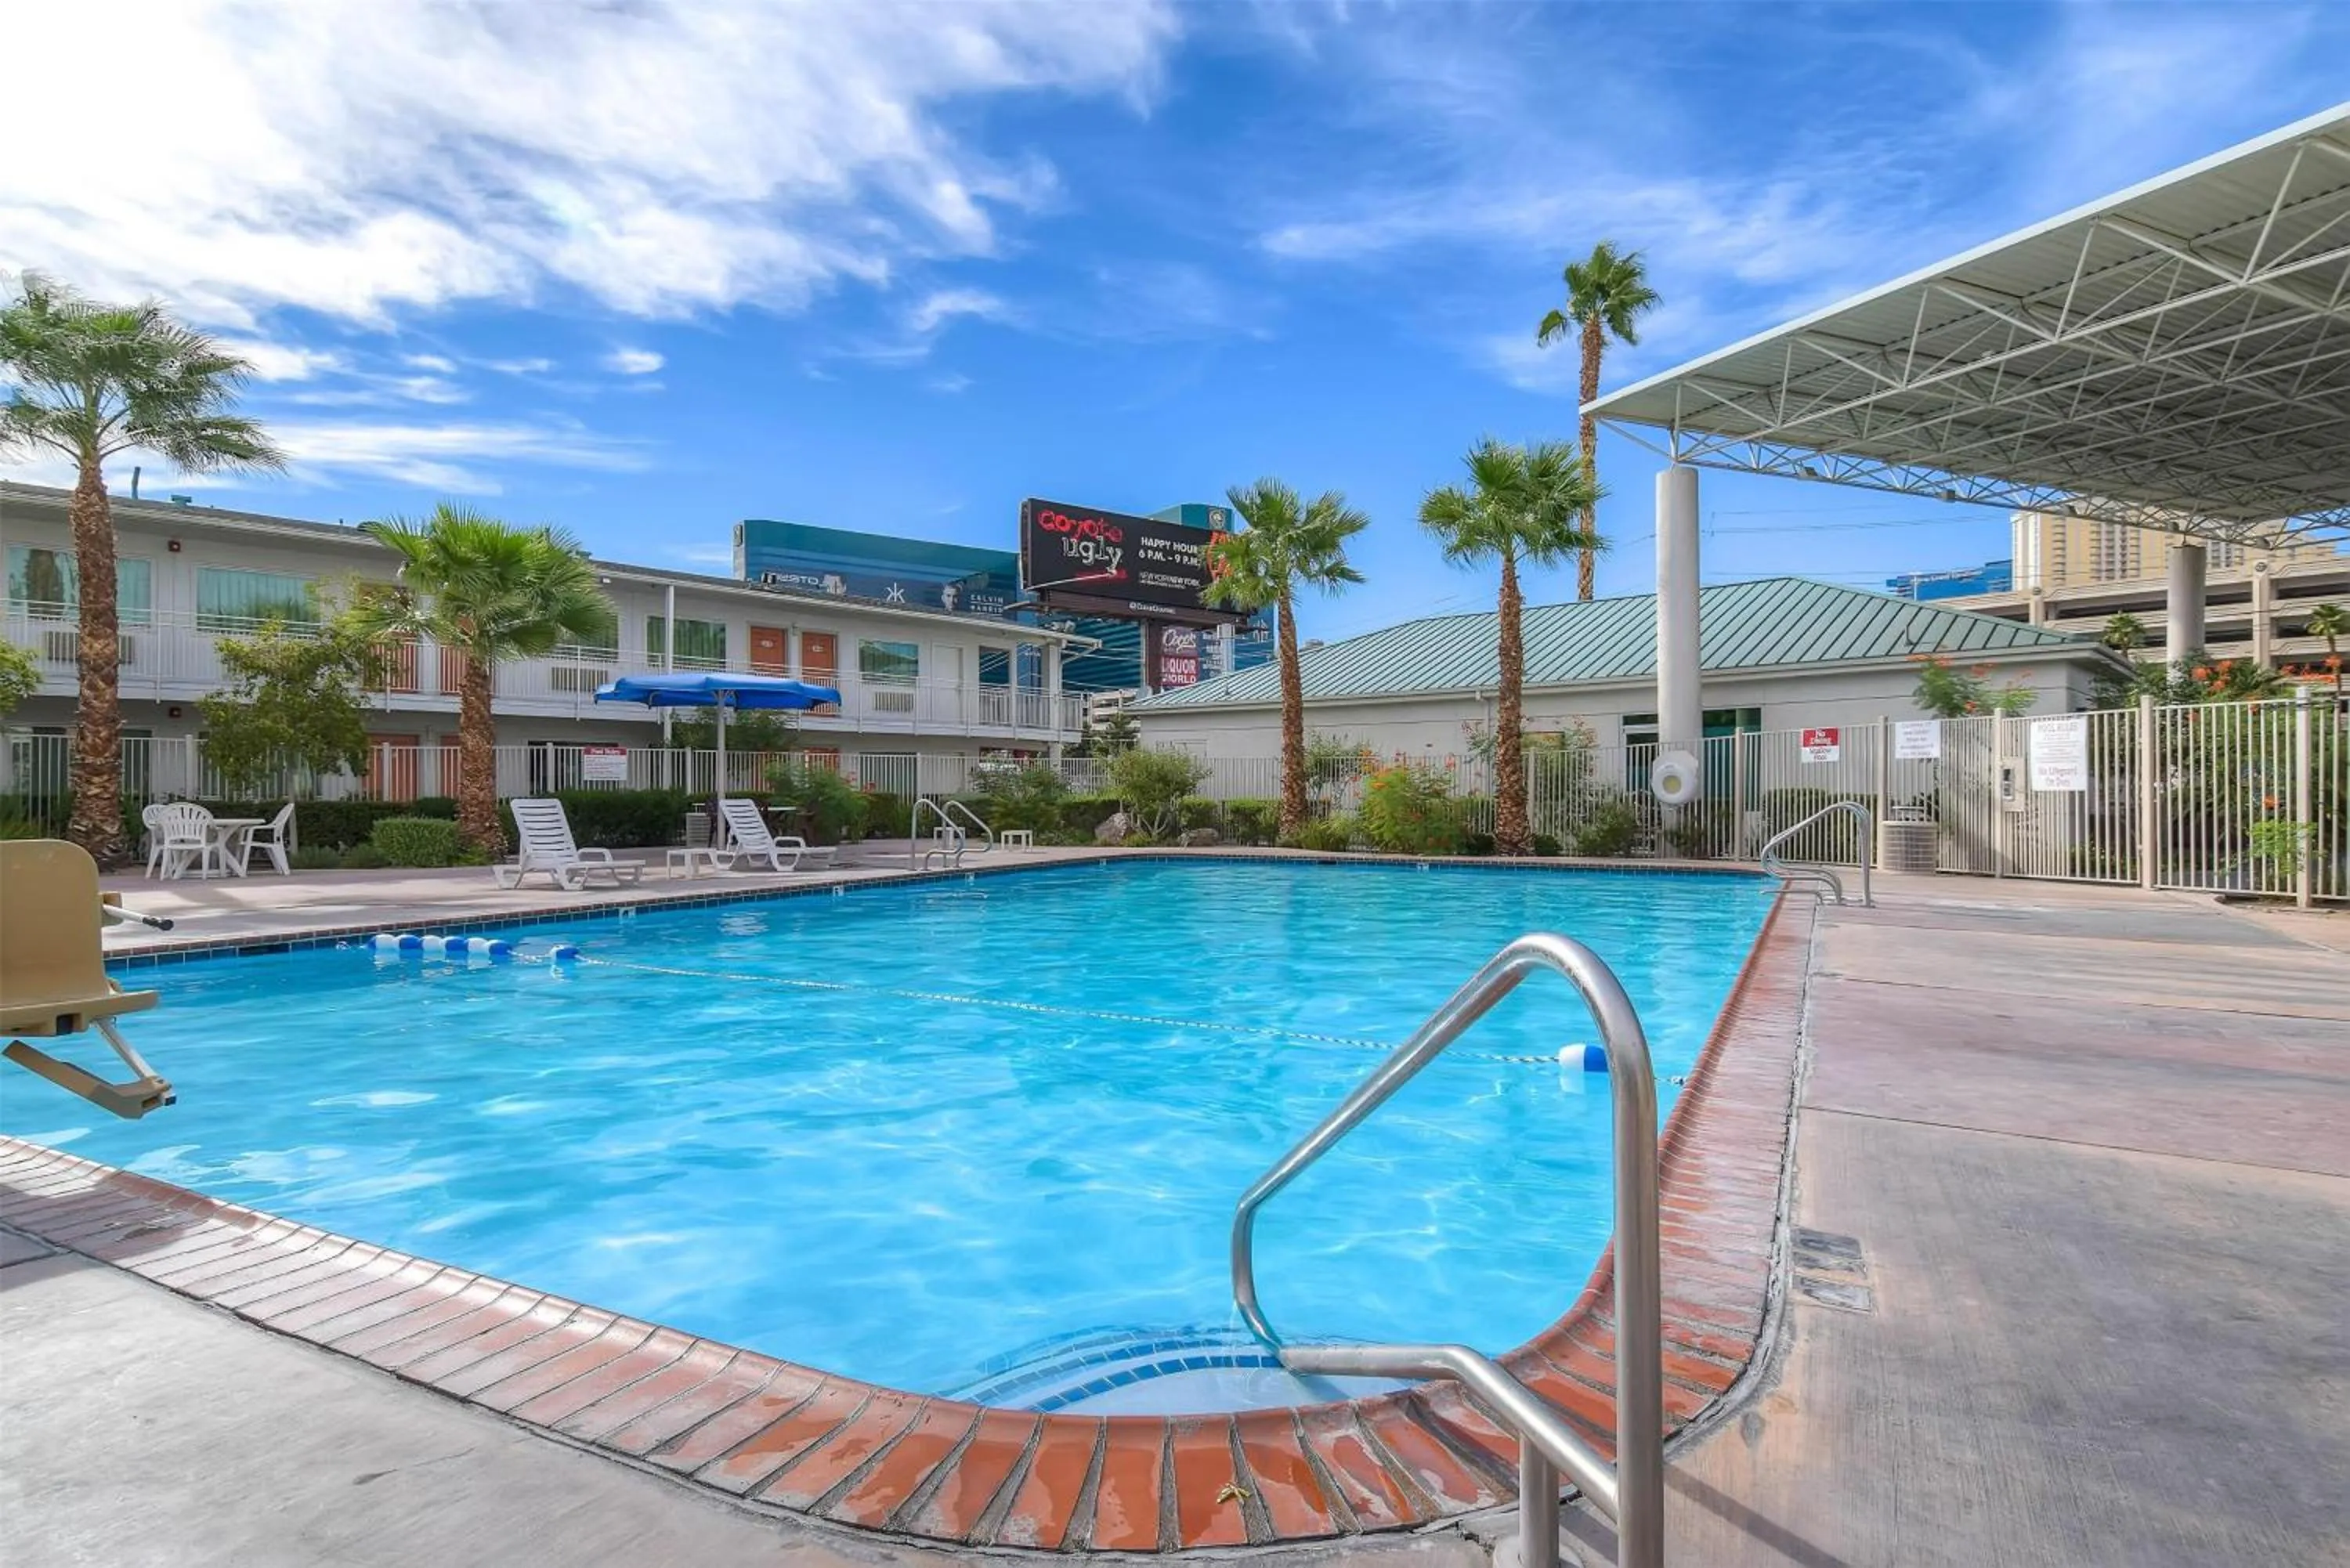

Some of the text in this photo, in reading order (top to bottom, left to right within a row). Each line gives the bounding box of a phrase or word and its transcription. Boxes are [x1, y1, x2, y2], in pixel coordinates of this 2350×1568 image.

[1141, 537, 1171, 551] HAPPY
[1061, 536, 1123, 573] ugly
[1138, 548, 1146, 558] 6
[1174, 554, 1181, 563] 9
[1162, 657, 1195, 674] LIQUOR
